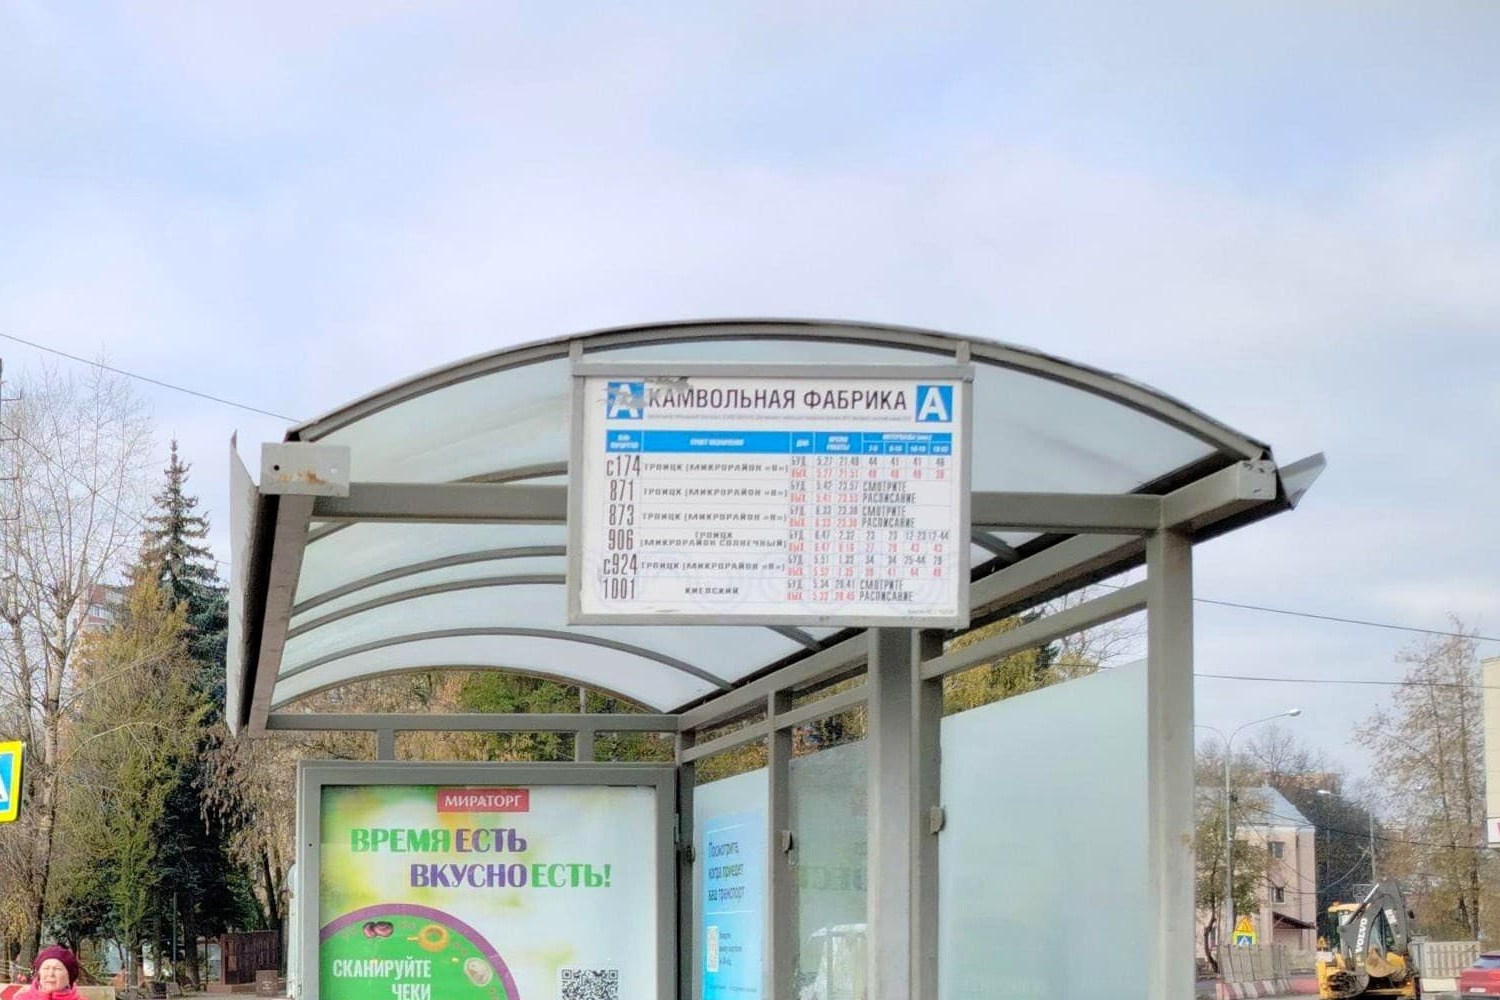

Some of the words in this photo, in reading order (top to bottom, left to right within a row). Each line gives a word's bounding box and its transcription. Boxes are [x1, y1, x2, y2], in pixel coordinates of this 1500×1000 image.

[648, 387, 795, 409] КАМВОЛЬНАЯ
[803, 390, 907, 410] ФАБРИКА
[606, 454, 641, 476] с174
[610, 479, 634, 502] 871
[609, 503, 634, 526] 873
[607, 528, 633, 551] 906
[603, 553, 638, 576] с924
[602, 578, 635, 600] 1001
[859, 591, 914, 602] РАСПИСАНИЕ
[445, 795, 522, 808] МИРАТОРГ
[350, 828, 451, 853] ВРЕМЯ
[455, 828, 527, 852] ЕСТЬ
[410, 864, 527, 888] ВКУСНО
[531, 864, 612, 888] ЕСТЬ!
[1355, 917, 1368, 953] VOLVO
[332, 955, 432, 979] СКАНИРУЙТЕ
[392, 983, 432, 1000] ЧЕКИ
